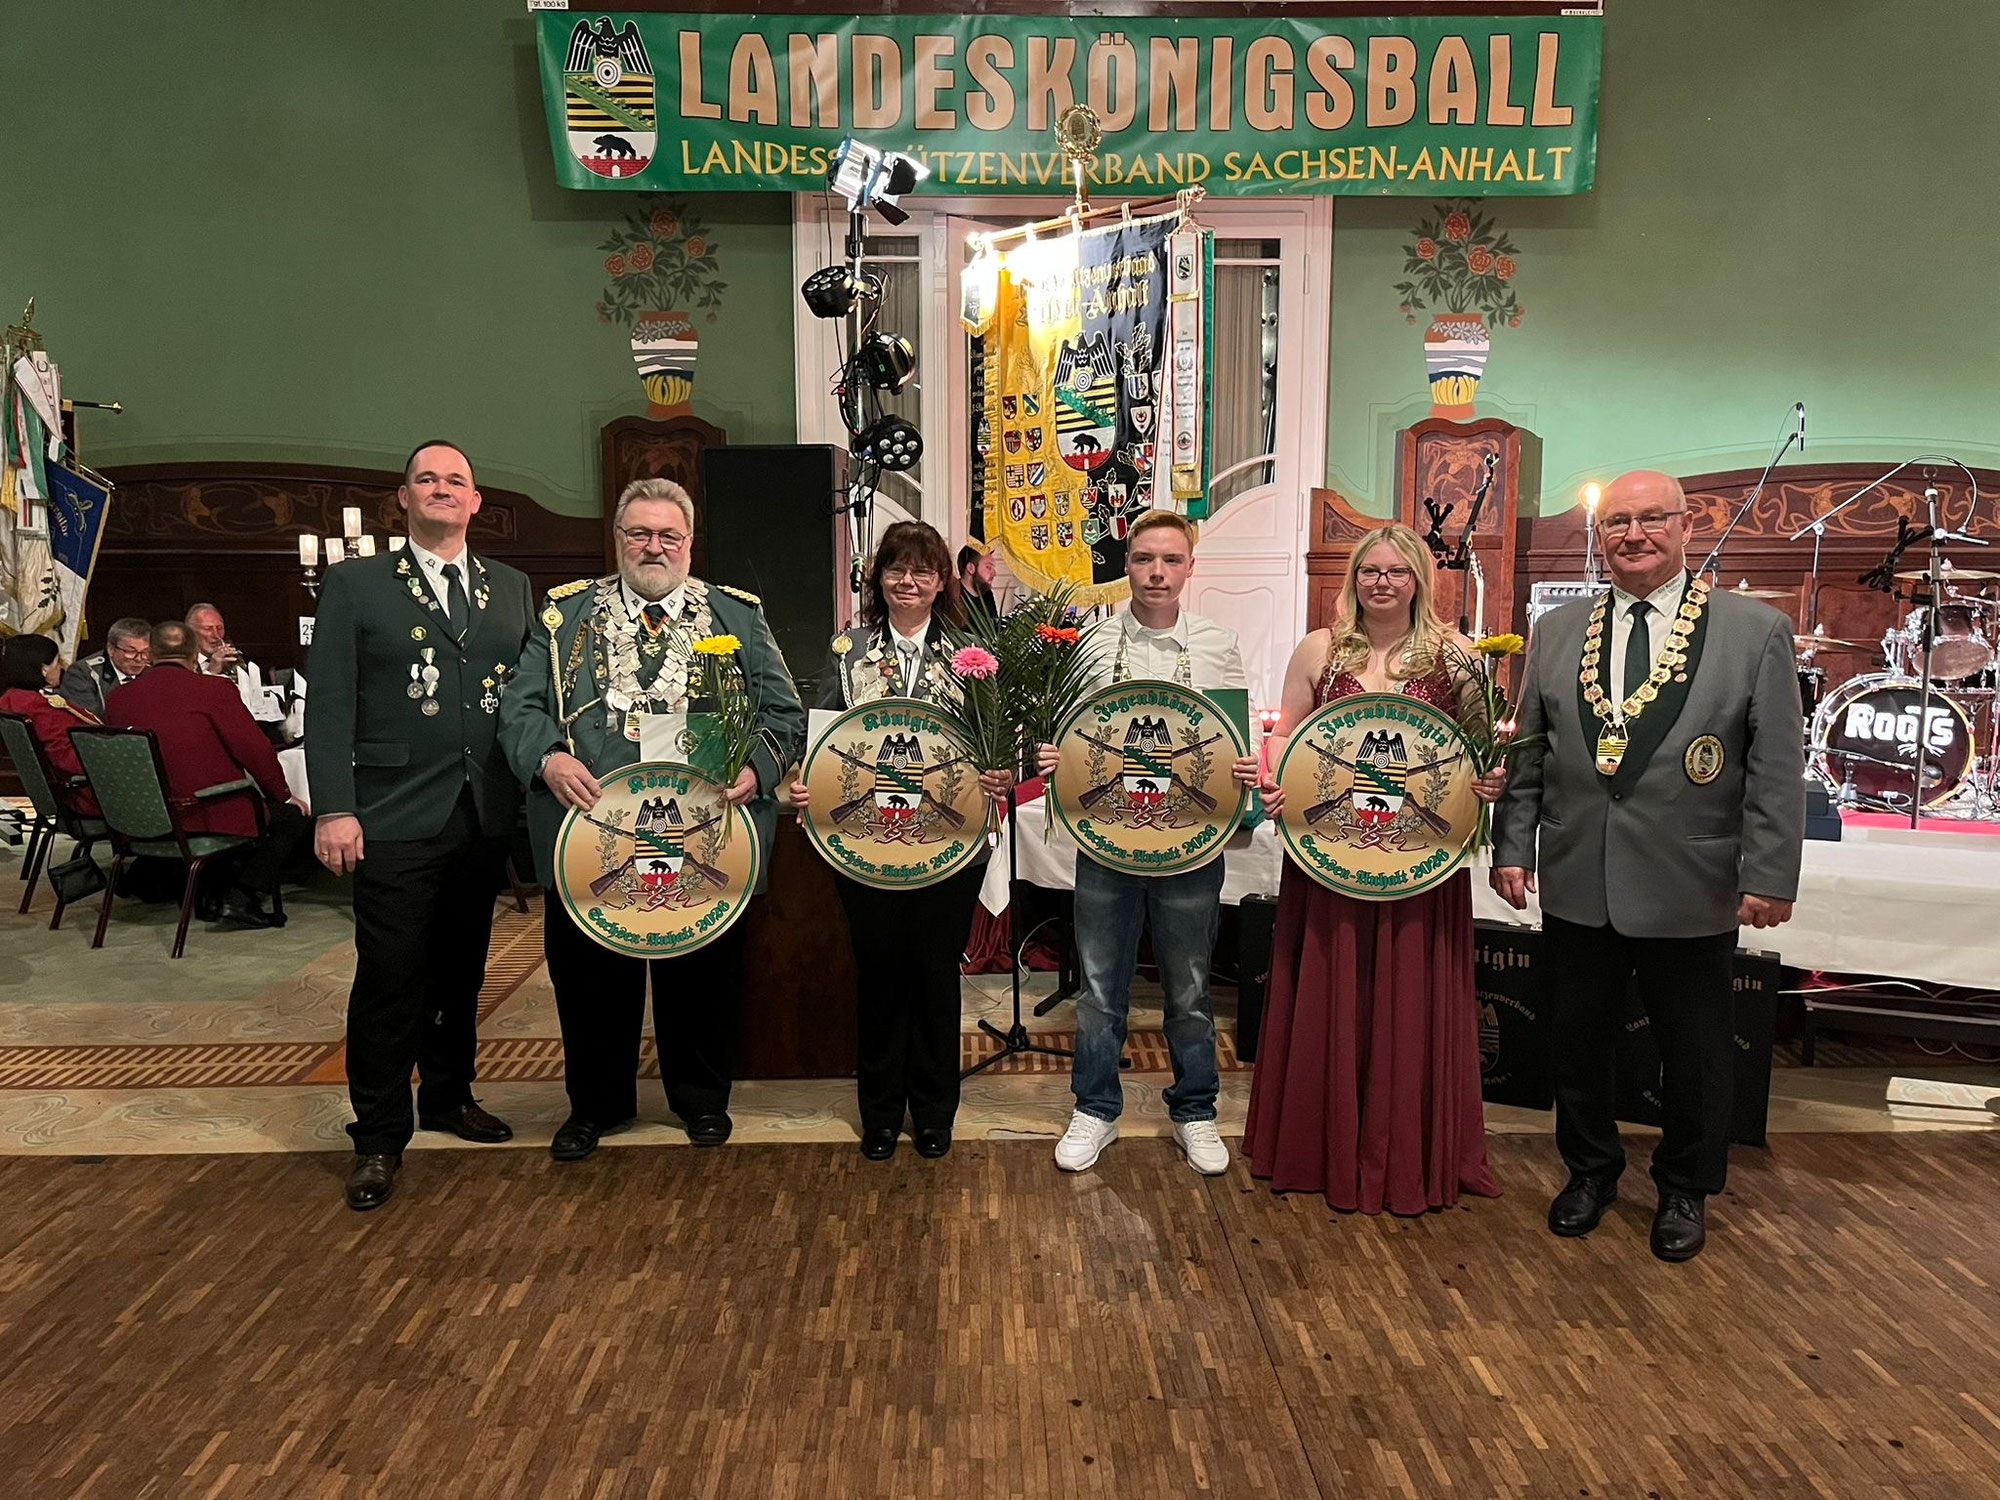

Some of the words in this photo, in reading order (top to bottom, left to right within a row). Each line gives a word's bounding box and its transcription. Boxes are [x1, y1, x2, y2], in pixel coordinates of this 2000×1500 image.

[678, 31, 1573, 132] LANDESKÖNIGSBALL
[681, 140, 1210, 184] LANDESÜTZENVERBAND
[1224, 146, 1573, 182] SACHSEN-ANHALT
[862, 709, 941, 735] Königin
[1093, 690, 1204, 726] Jugendkönig
[1317, 703, 1448, 747] Jugendkönigin
[628, 772, 690, 795] König
